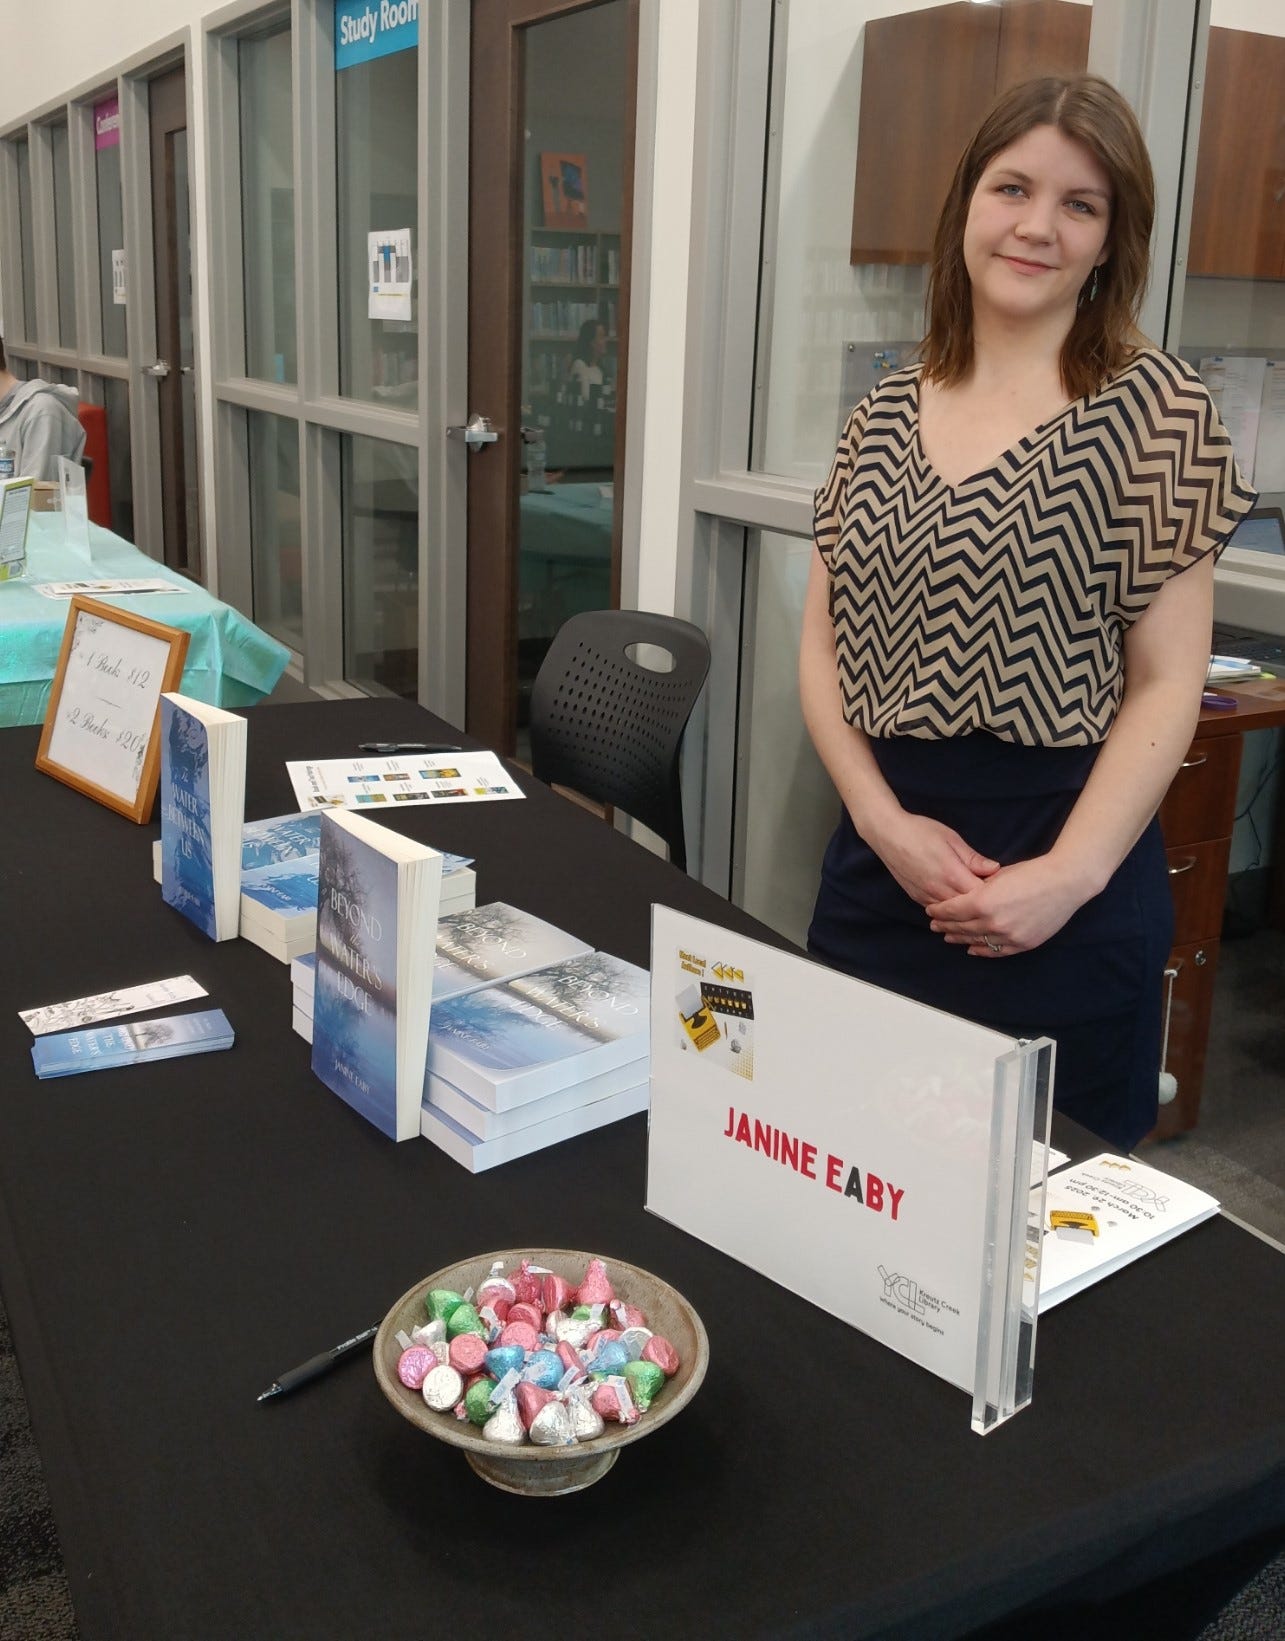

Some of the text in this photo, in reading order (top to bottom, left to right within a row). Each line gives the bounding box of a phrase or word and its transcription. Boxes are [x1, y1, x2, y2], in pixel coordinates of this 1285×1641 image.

[340, 6, 378, 46] Study
[127, 667, 151, 689] $12
[69, 706, 81, 725] 2
[171, 782, 200, 818] WATER
[330, 887, 383, 942] BEYOND
[455, 922, 527, 959] BEYOND
[329, 931, 384, 991] WATER'S
[336, 970, 373, 1017] EDGE
[558, 975, 639, 1015] BEYOND
[724, 1106, 905, 1221] JANINE EABY
[1107, 1202, 1140, 1220] March
[918, 1295, 941, 1313] Library
[925, 1321, 945, 1336] begins
